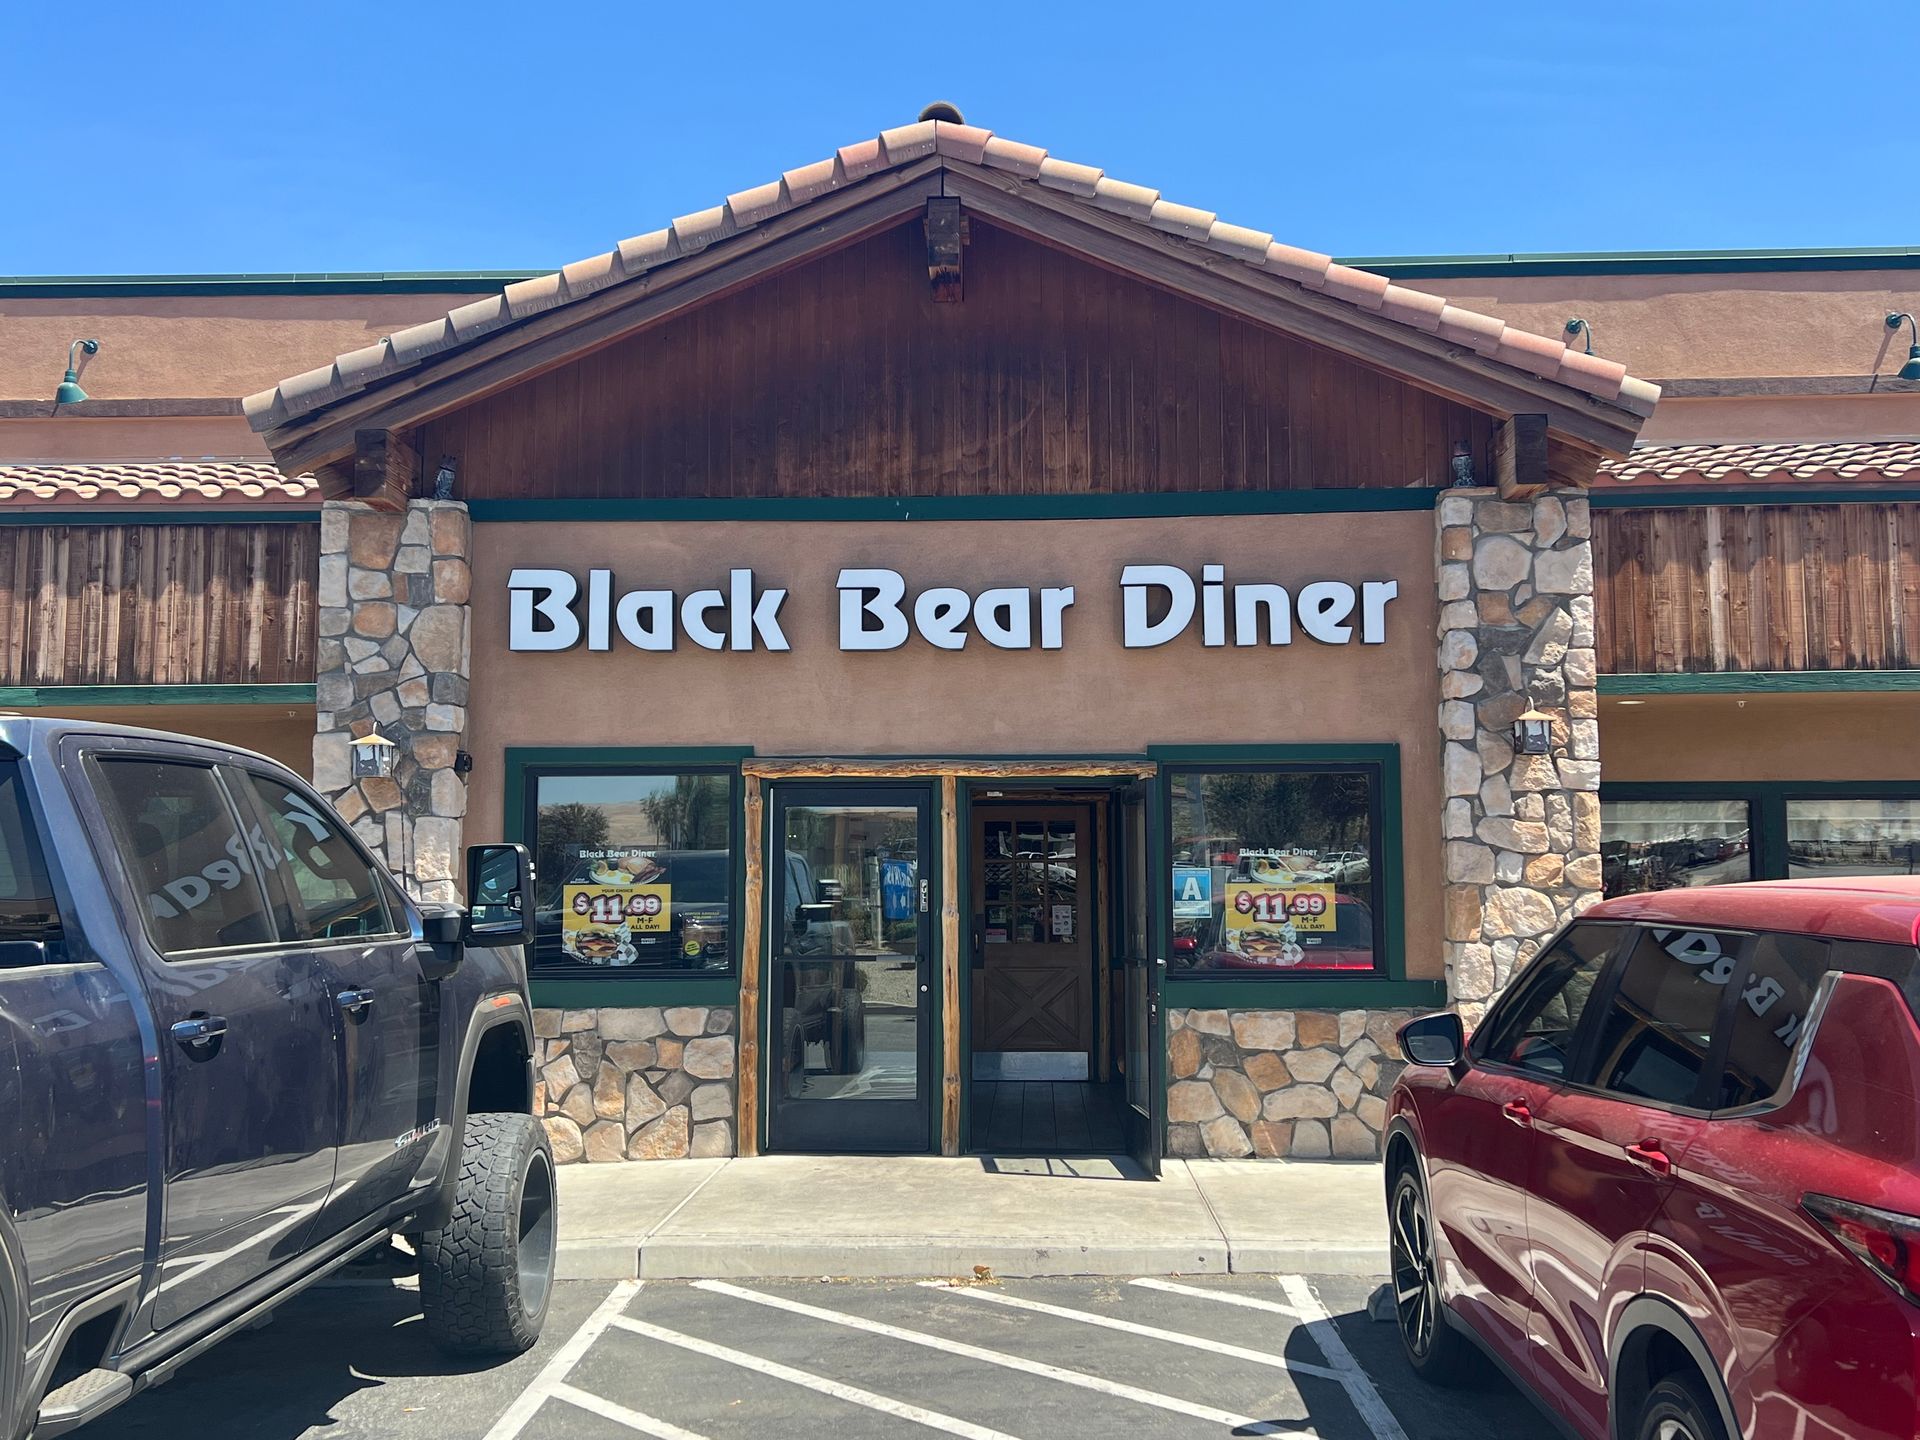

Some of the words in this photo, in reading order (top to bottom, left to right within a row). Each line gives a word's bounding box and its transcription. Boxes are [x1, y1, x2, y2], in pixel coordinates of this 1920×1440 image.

[507, 568, 791, 653] Black
[836, 567, 1075, 652] Bear
[1119, 563, 1399, 649] Diner
[579, 850, 604, 859] Black
[607, 849, 629, 858] Bear
[631, 849, 656, 858] Diner
[1239, 848, 1265, 856] Black
[1268, 848, 1290, 856] Bear
[1293, 848, 1318, 856] Diner
[1182, 877, 1202, 900] A
[573, 892, 662, 924] $11.99
[1235, 891, 1326, 923] $11.99
